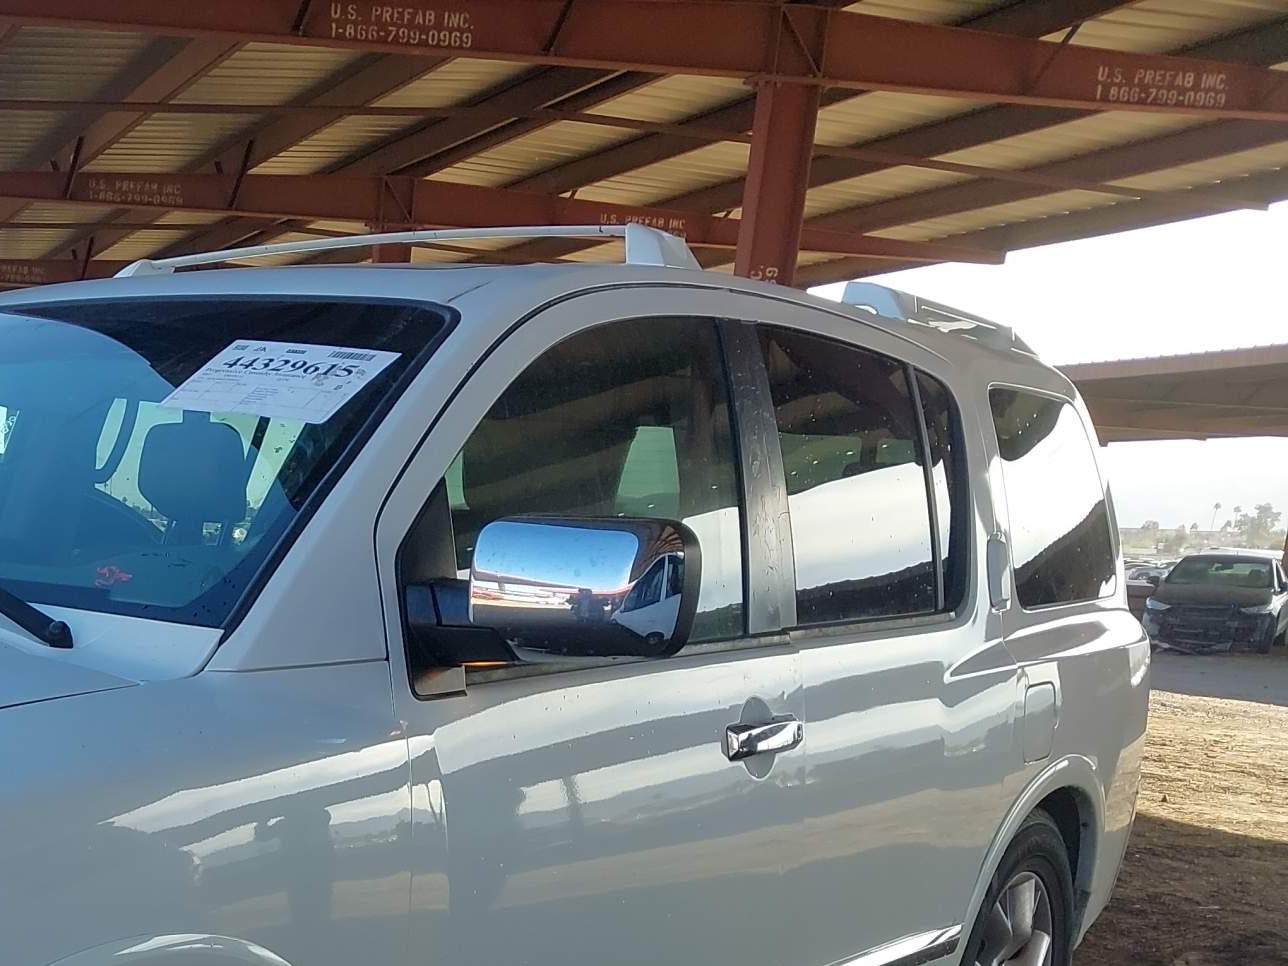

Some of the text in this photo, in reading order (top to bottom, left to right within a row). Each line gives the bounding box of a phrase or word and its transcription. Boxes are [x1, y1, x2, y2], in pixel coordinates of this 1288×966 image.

[330, 3, 475, 30] U.S. PREFAB INC.
[330, 22, 473, 49] 1-866-799-0969
[1097, 65, 1229, 91] U.S. PREFAB INC.
[115, 180, 159, 193] PREFAB
[624, 215, 665, 229] PREFAB
[223, 355, 361, 378] 44329615
